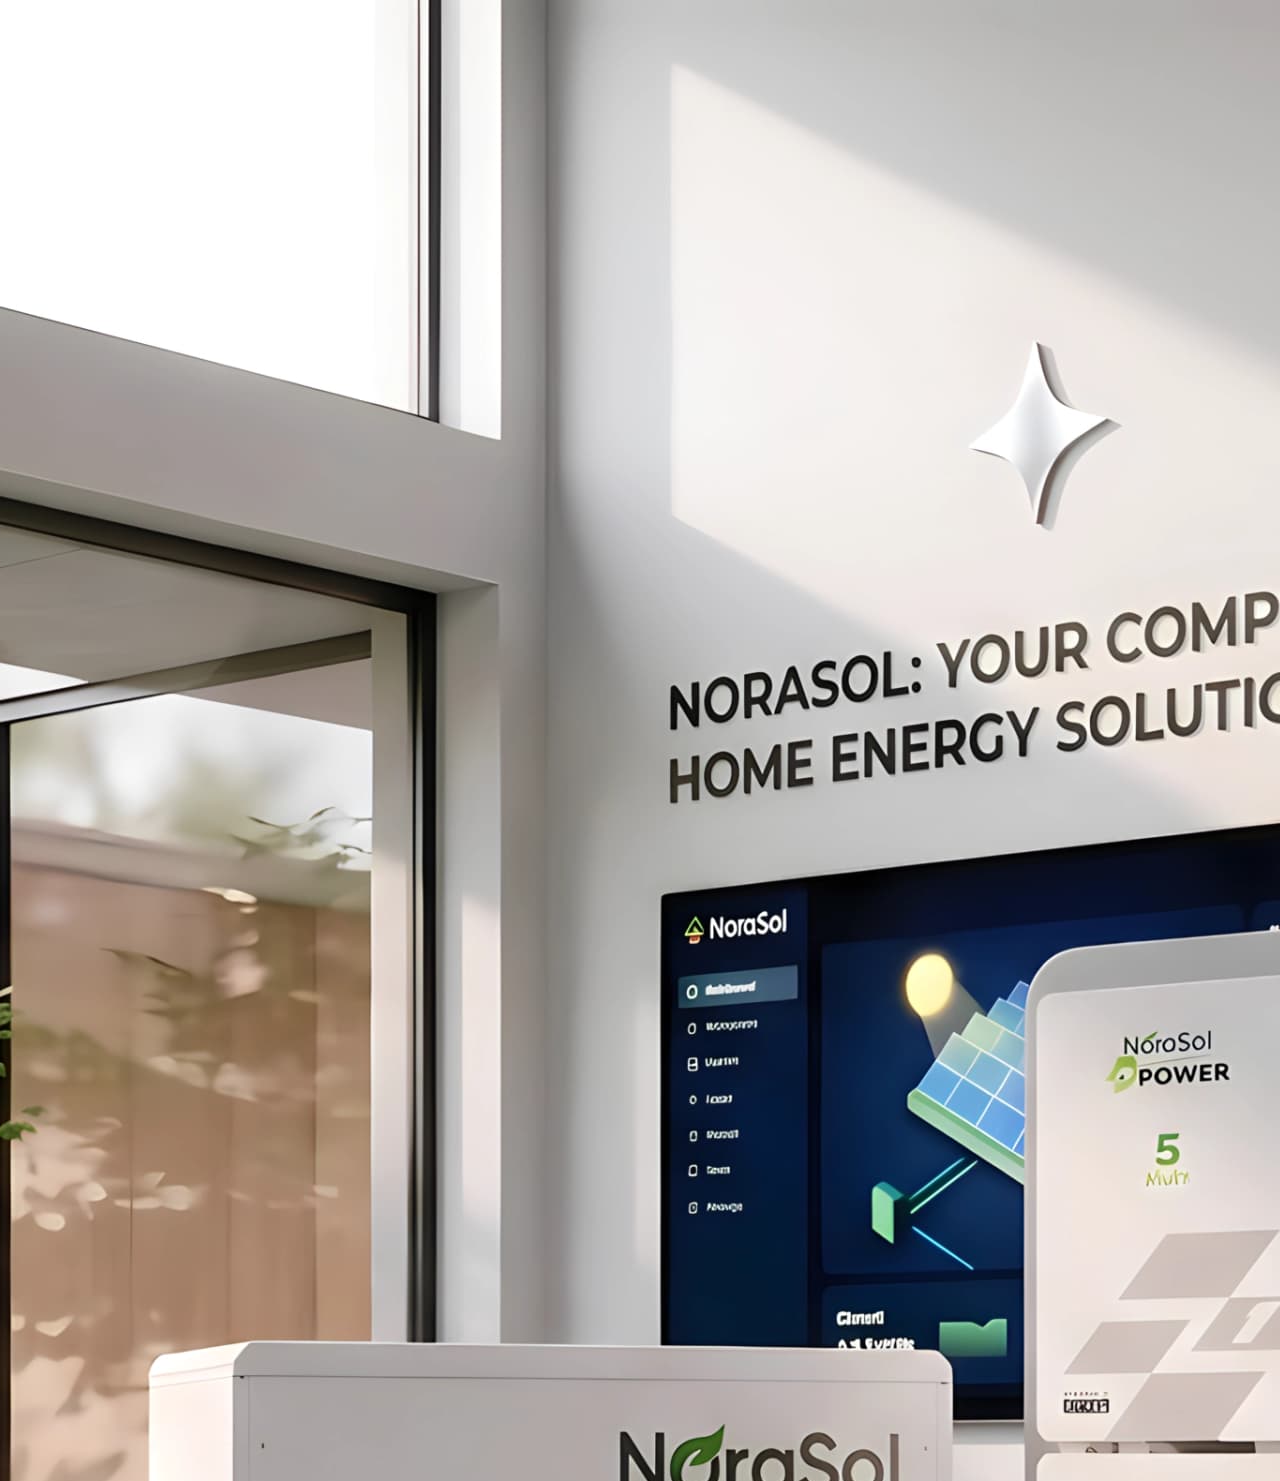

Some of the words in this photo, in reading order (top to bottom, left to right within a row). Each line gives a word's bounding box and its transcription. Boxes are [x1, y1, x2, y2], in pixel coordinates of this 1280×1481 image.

[668, 649, 923, 731] NORASOL:
[936, 621, 1089, 688] YOUR
[667, 739, 814, 804] HOME
[831, 705, 1040, 781] ENERGY
[709, 908, 788, 940] NoraSol
[1138, 1063, 1230, 1087] POWER
[1155, 1133, 1181, 1166] 5
